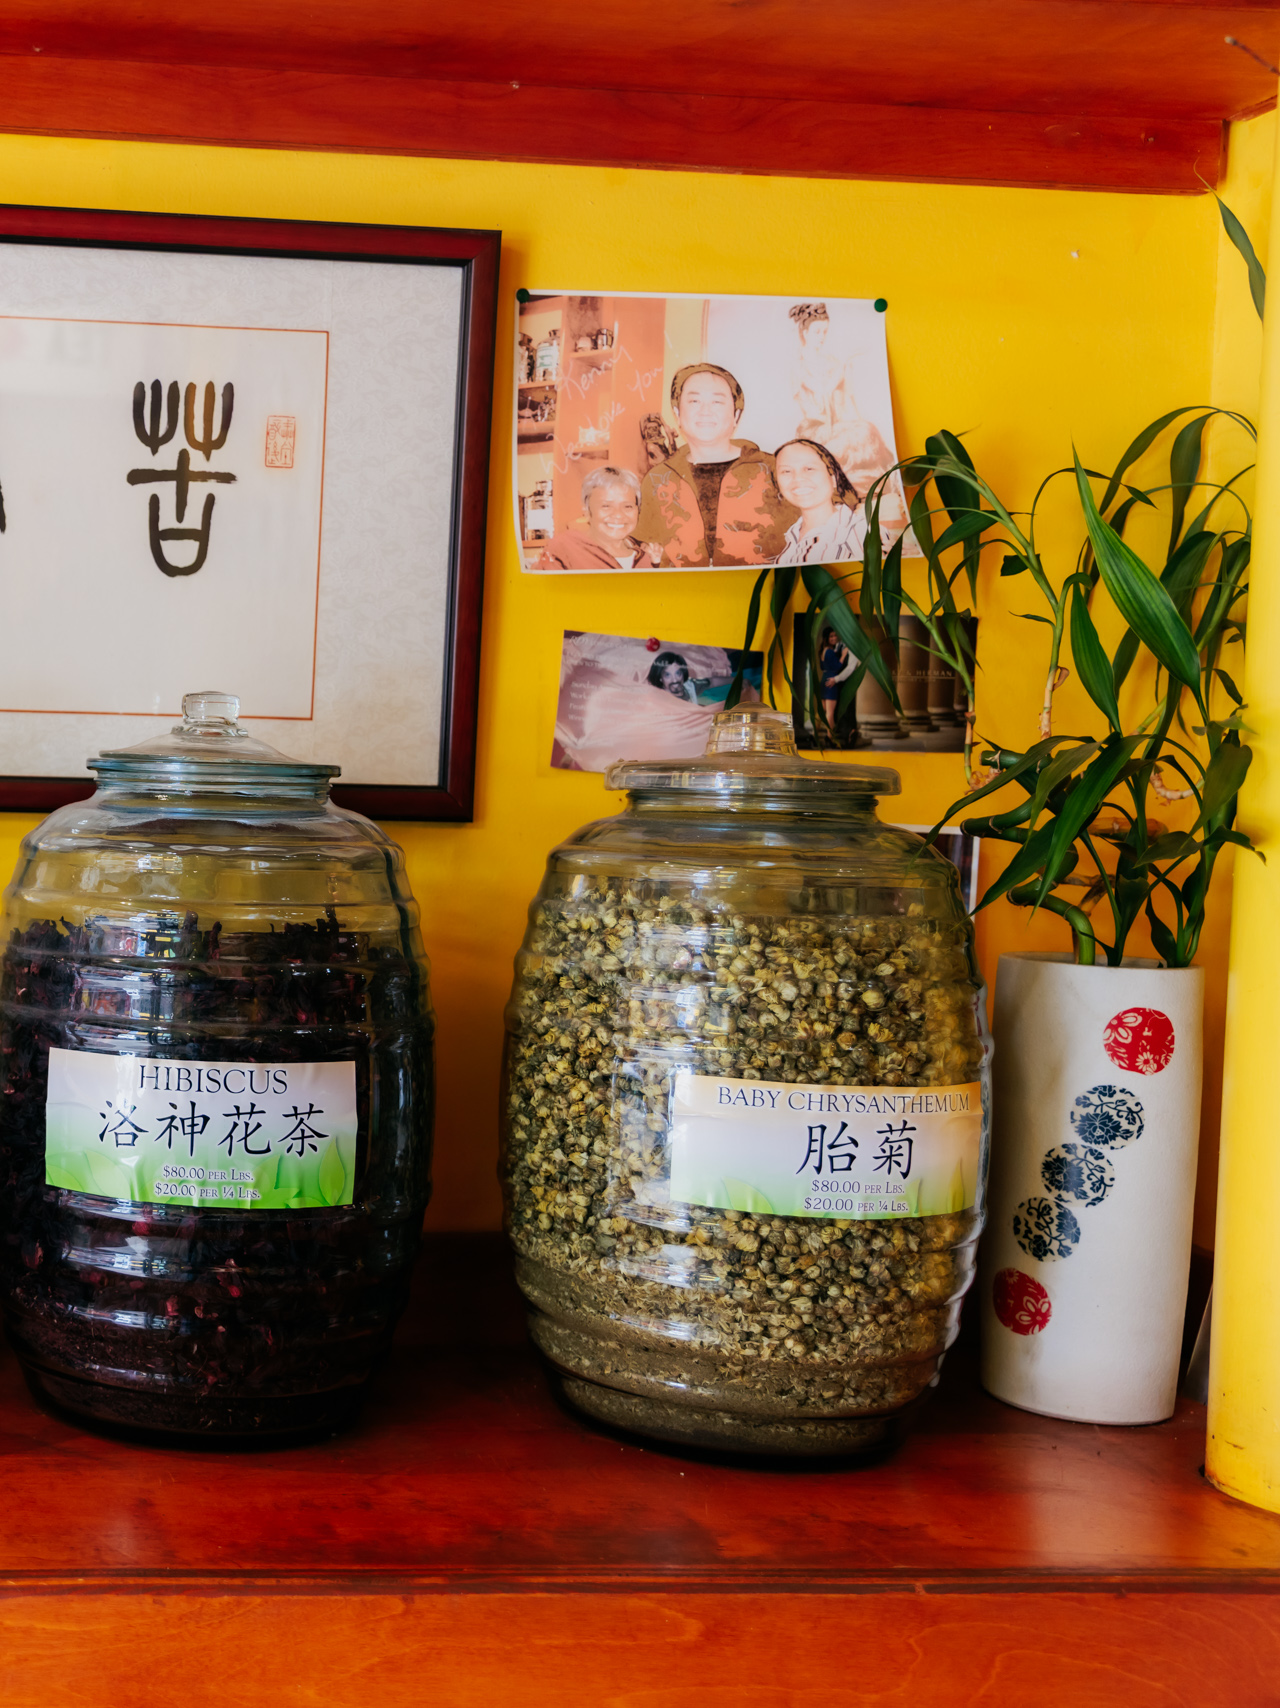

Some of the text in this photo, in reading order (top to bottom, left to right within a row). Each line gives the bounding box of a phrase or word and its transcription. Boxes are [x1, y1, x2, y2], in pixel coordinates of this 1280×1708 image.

[139, 1064, 288, 1095] HIBISCUS
[717, 1086, 970, 1115] BABY CHRYSANTHEMUM
[98, 1100, 330, 1158] 洛神花茶
[795, 1119, 918, 1180] 胎菊
[163, 1165, 205, 1180] $80.00
[154, 1182, 197, 1197] $20.00
[811, 1179, 861, 1194] $80.00
[804, 1196, 854, 1212] $20.00
